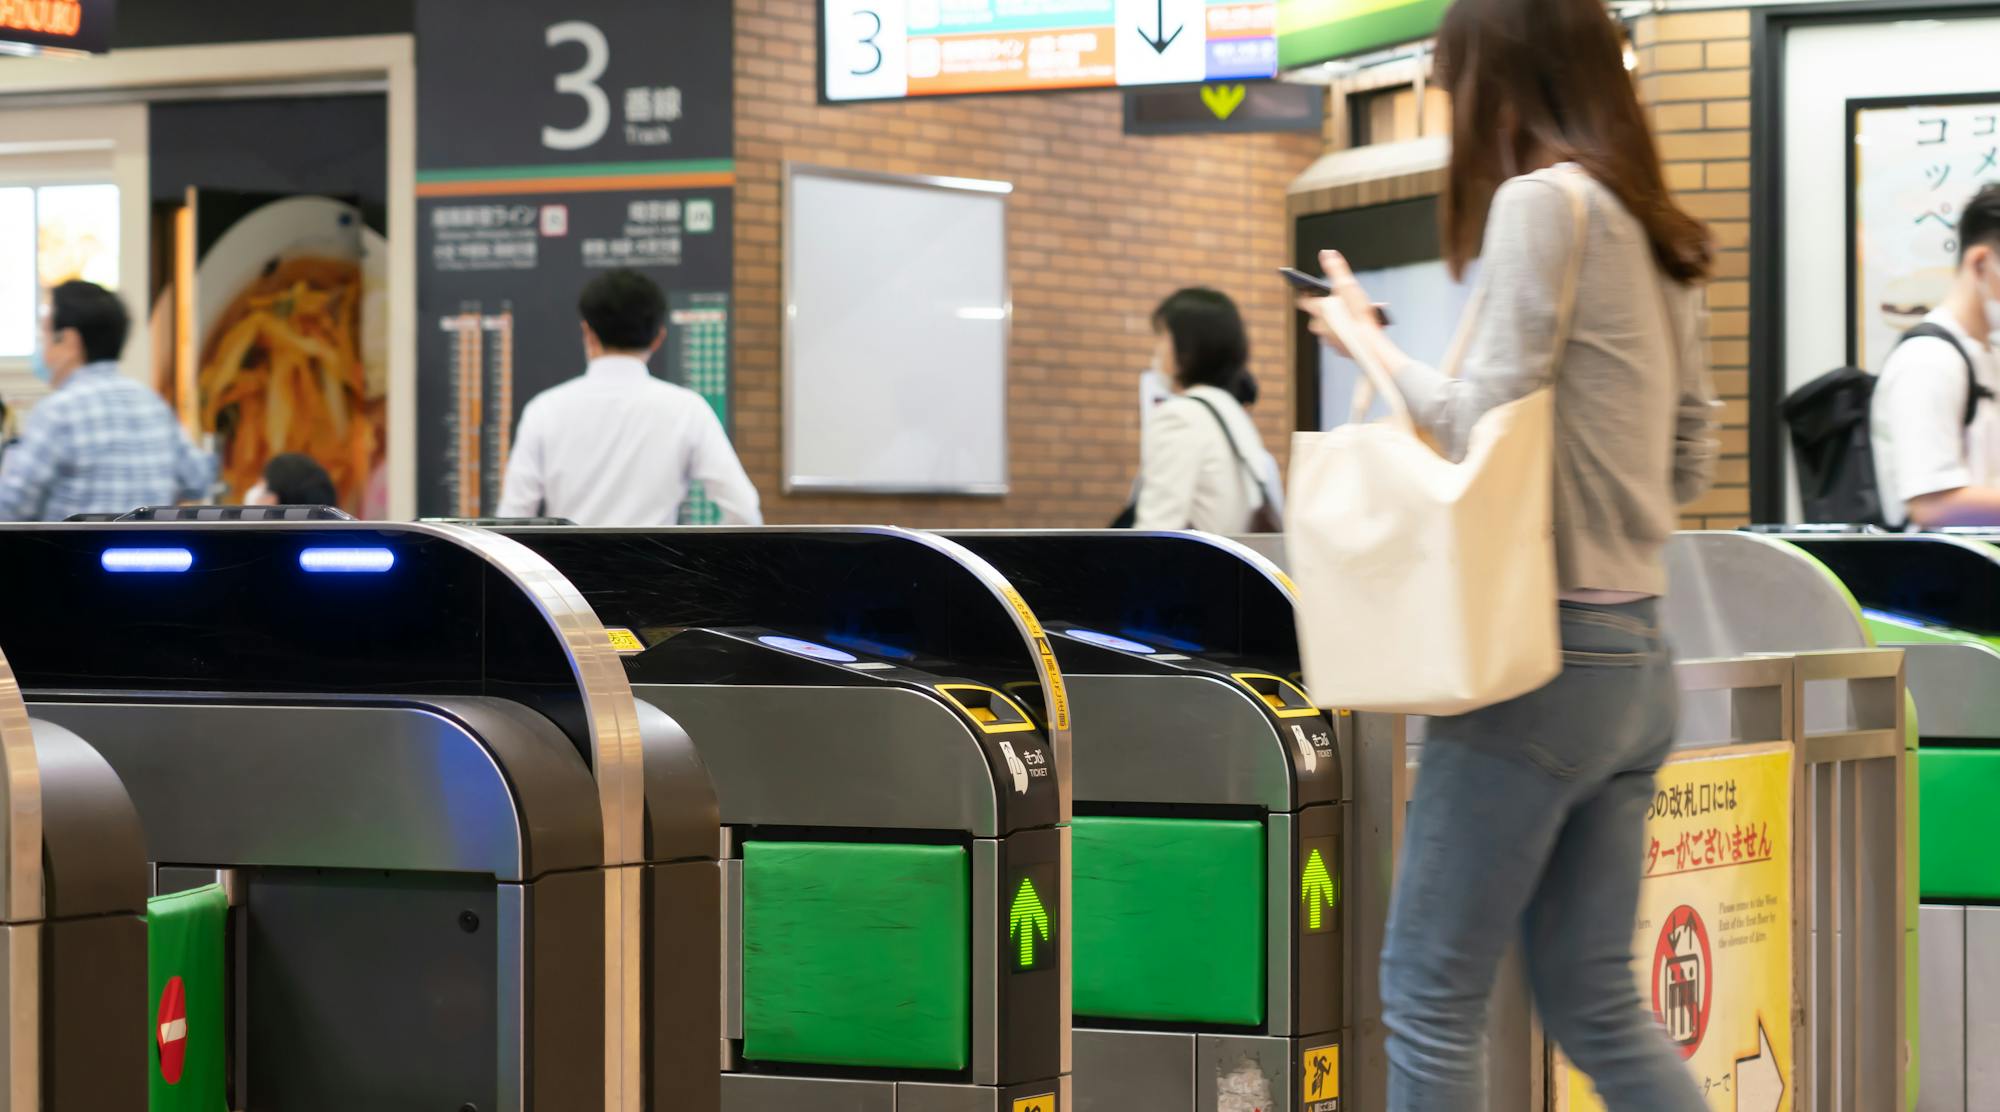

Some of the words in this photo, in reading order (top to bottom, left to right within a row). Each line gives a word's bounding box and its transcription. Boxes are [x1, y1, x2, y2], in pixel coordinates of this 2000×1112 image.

[850, 9, 882, 75] 3
[542, 20, 610, 149] 3
[1023, 748, 1045, 765] きっぷ
[1029, 767, 1048, 777] TICKET
[1646, 822, 1772, 874] ターがございません
[1699, 1072, 1731, 1097] ターで
